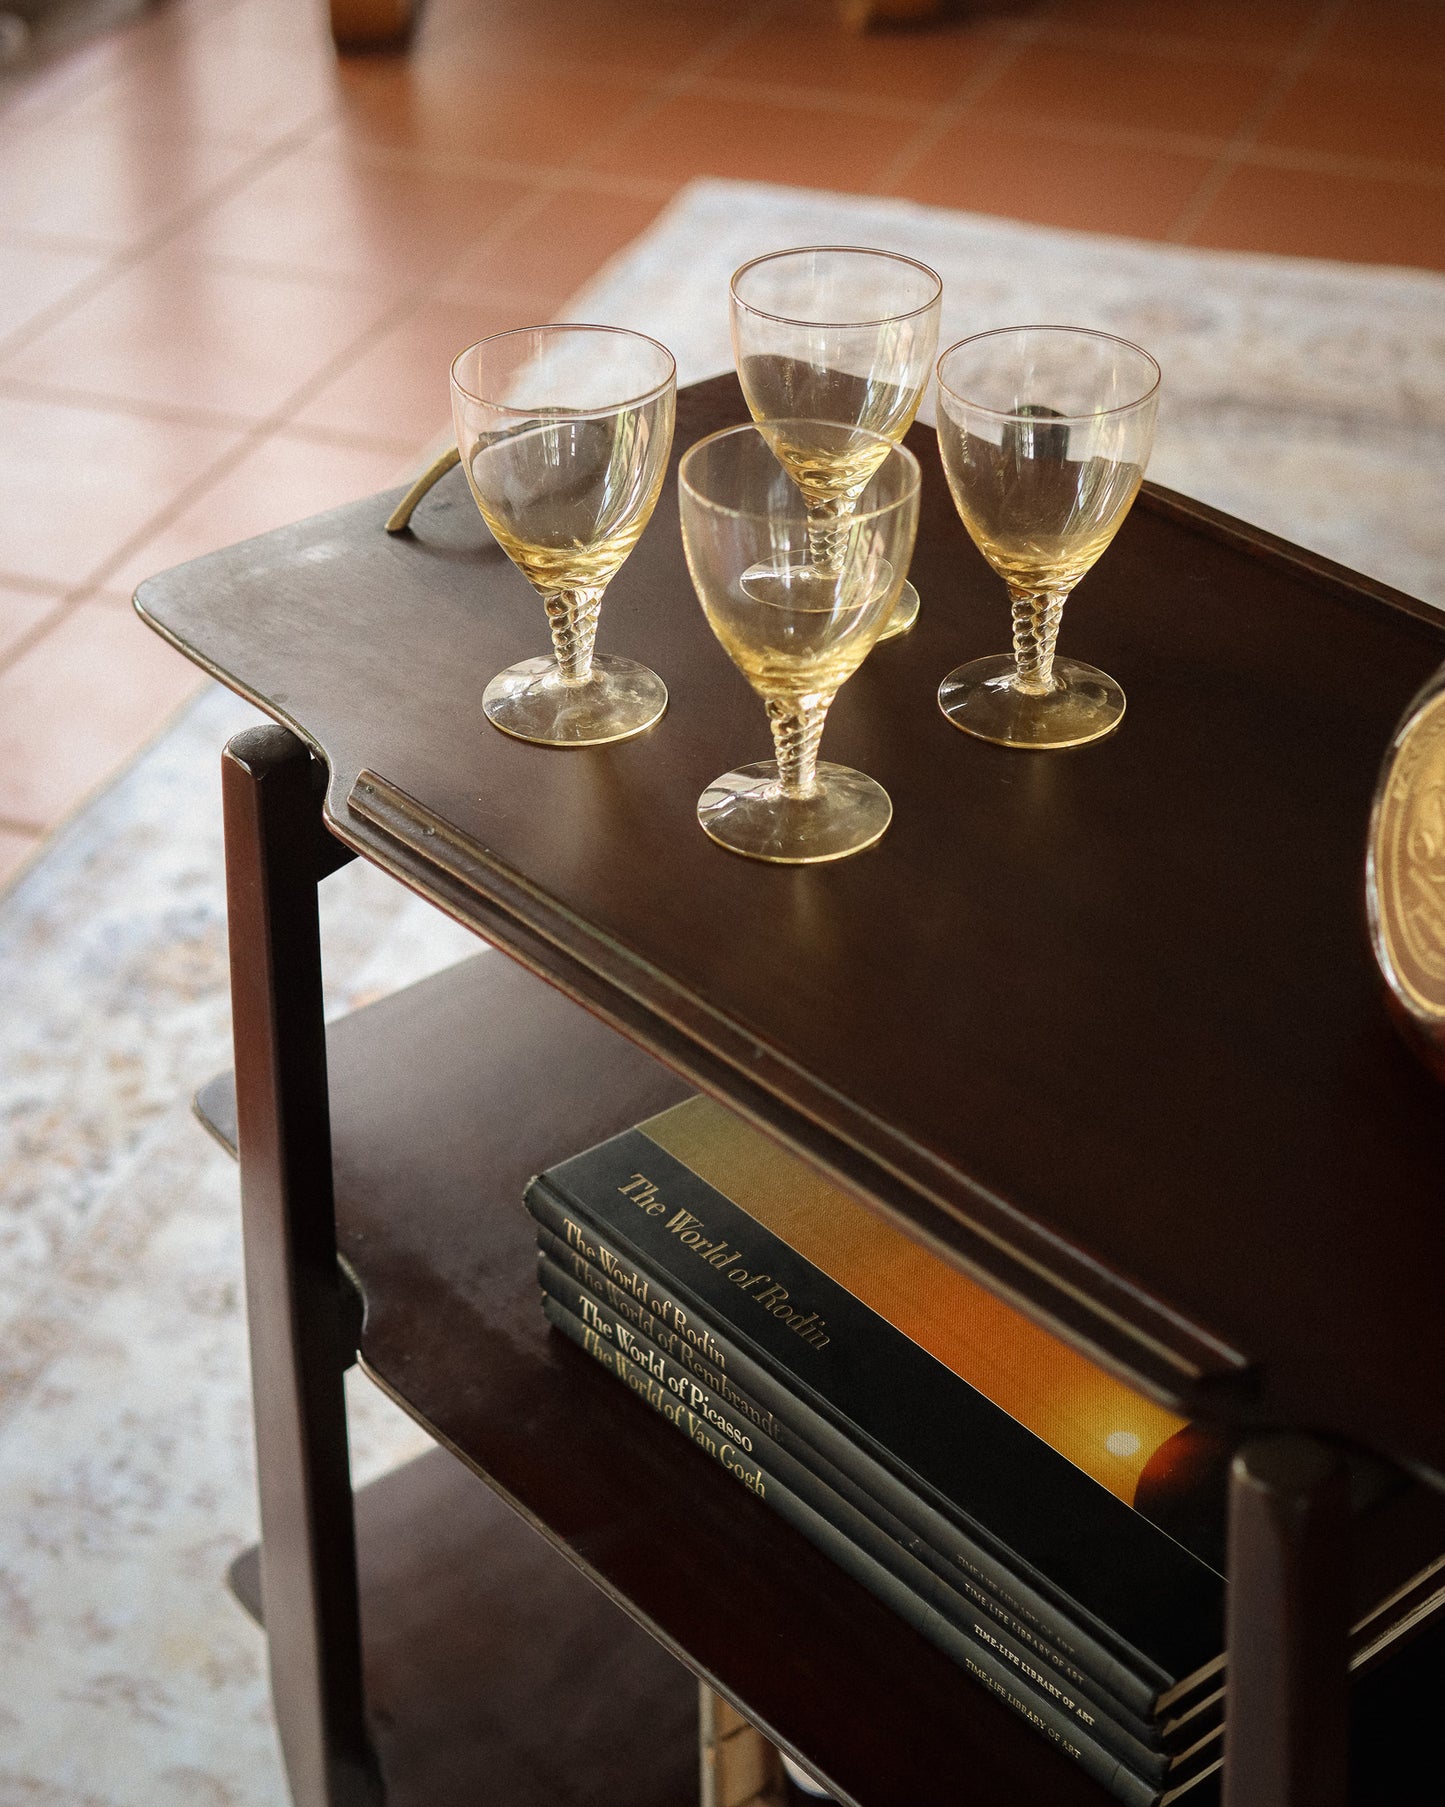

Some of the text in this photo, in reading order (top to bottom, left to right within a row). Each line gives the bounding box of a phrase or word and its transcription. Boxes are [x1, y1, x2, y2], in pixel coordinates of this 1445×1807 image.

[563, 1217, 726, 1369] The World of Rodin
[617, 1173, 832, 1351] The World of Rodin
[571, 1252, 782, 1440] The World of Rembrandt
[579, 1296, 753, 1452] The World of Picasso
[581, 1323, 766, 1499] The World of Van Gogh
[965, 1658, 1081, 1759] TIME-LIFE LIBRARY OF ART
[974, 1623, 1095, 1726] TIME-LIFE LIBRARY OF ART
[1012, 1622, 1050, 1656] LIBRARY
[1052, 1654, 1064, 1668] OF
[1065, 1666, 1085, 1685] ART
